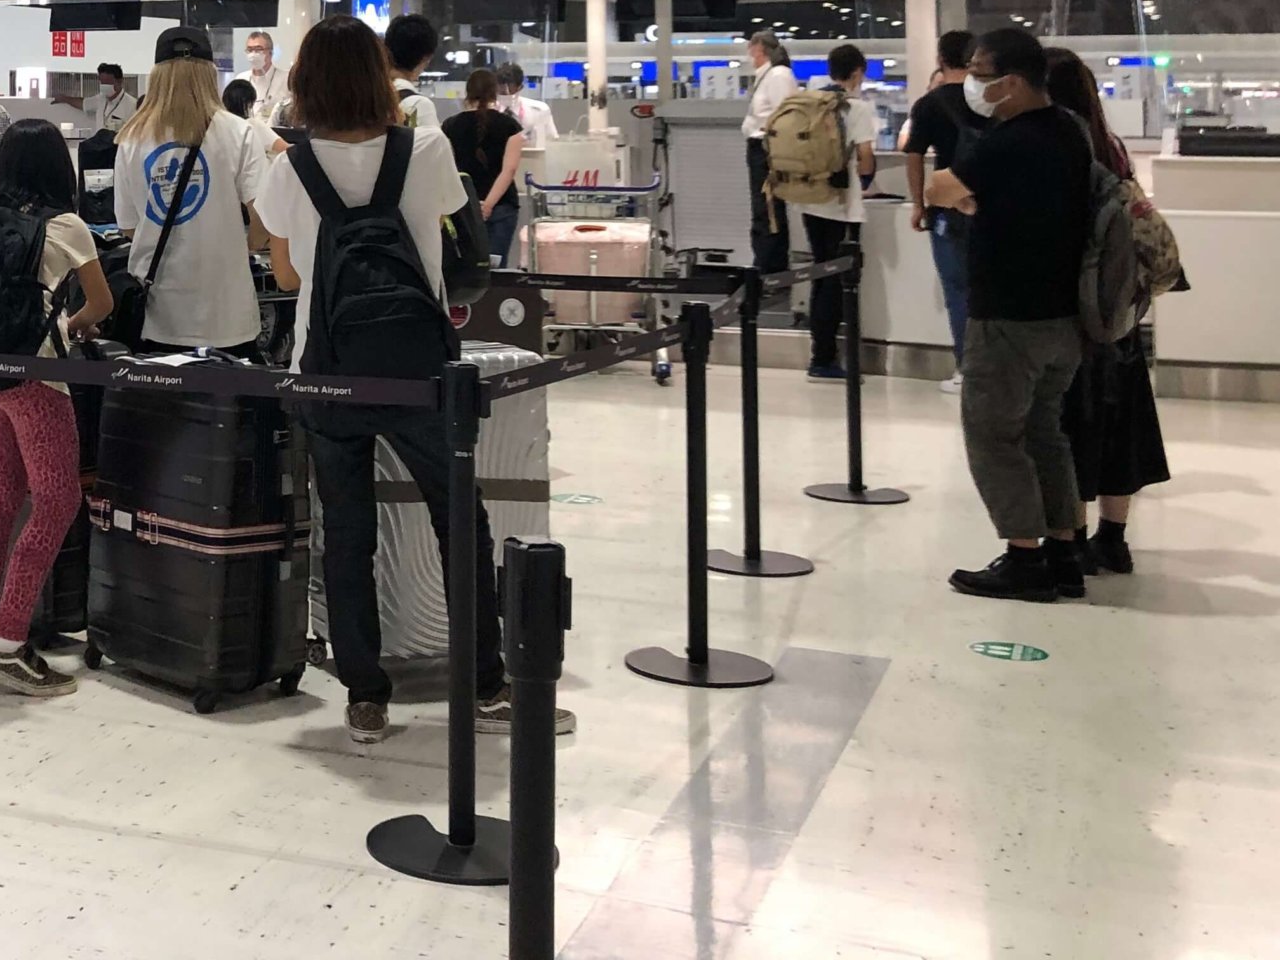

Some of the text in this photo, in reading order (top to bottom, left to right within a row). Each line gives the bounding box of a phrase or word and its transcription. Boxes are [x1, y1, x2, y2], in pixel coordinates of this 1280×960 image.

[127, 372, 182, 386] Narita Airport
[292, 383, 352, 397] Narita Airport
